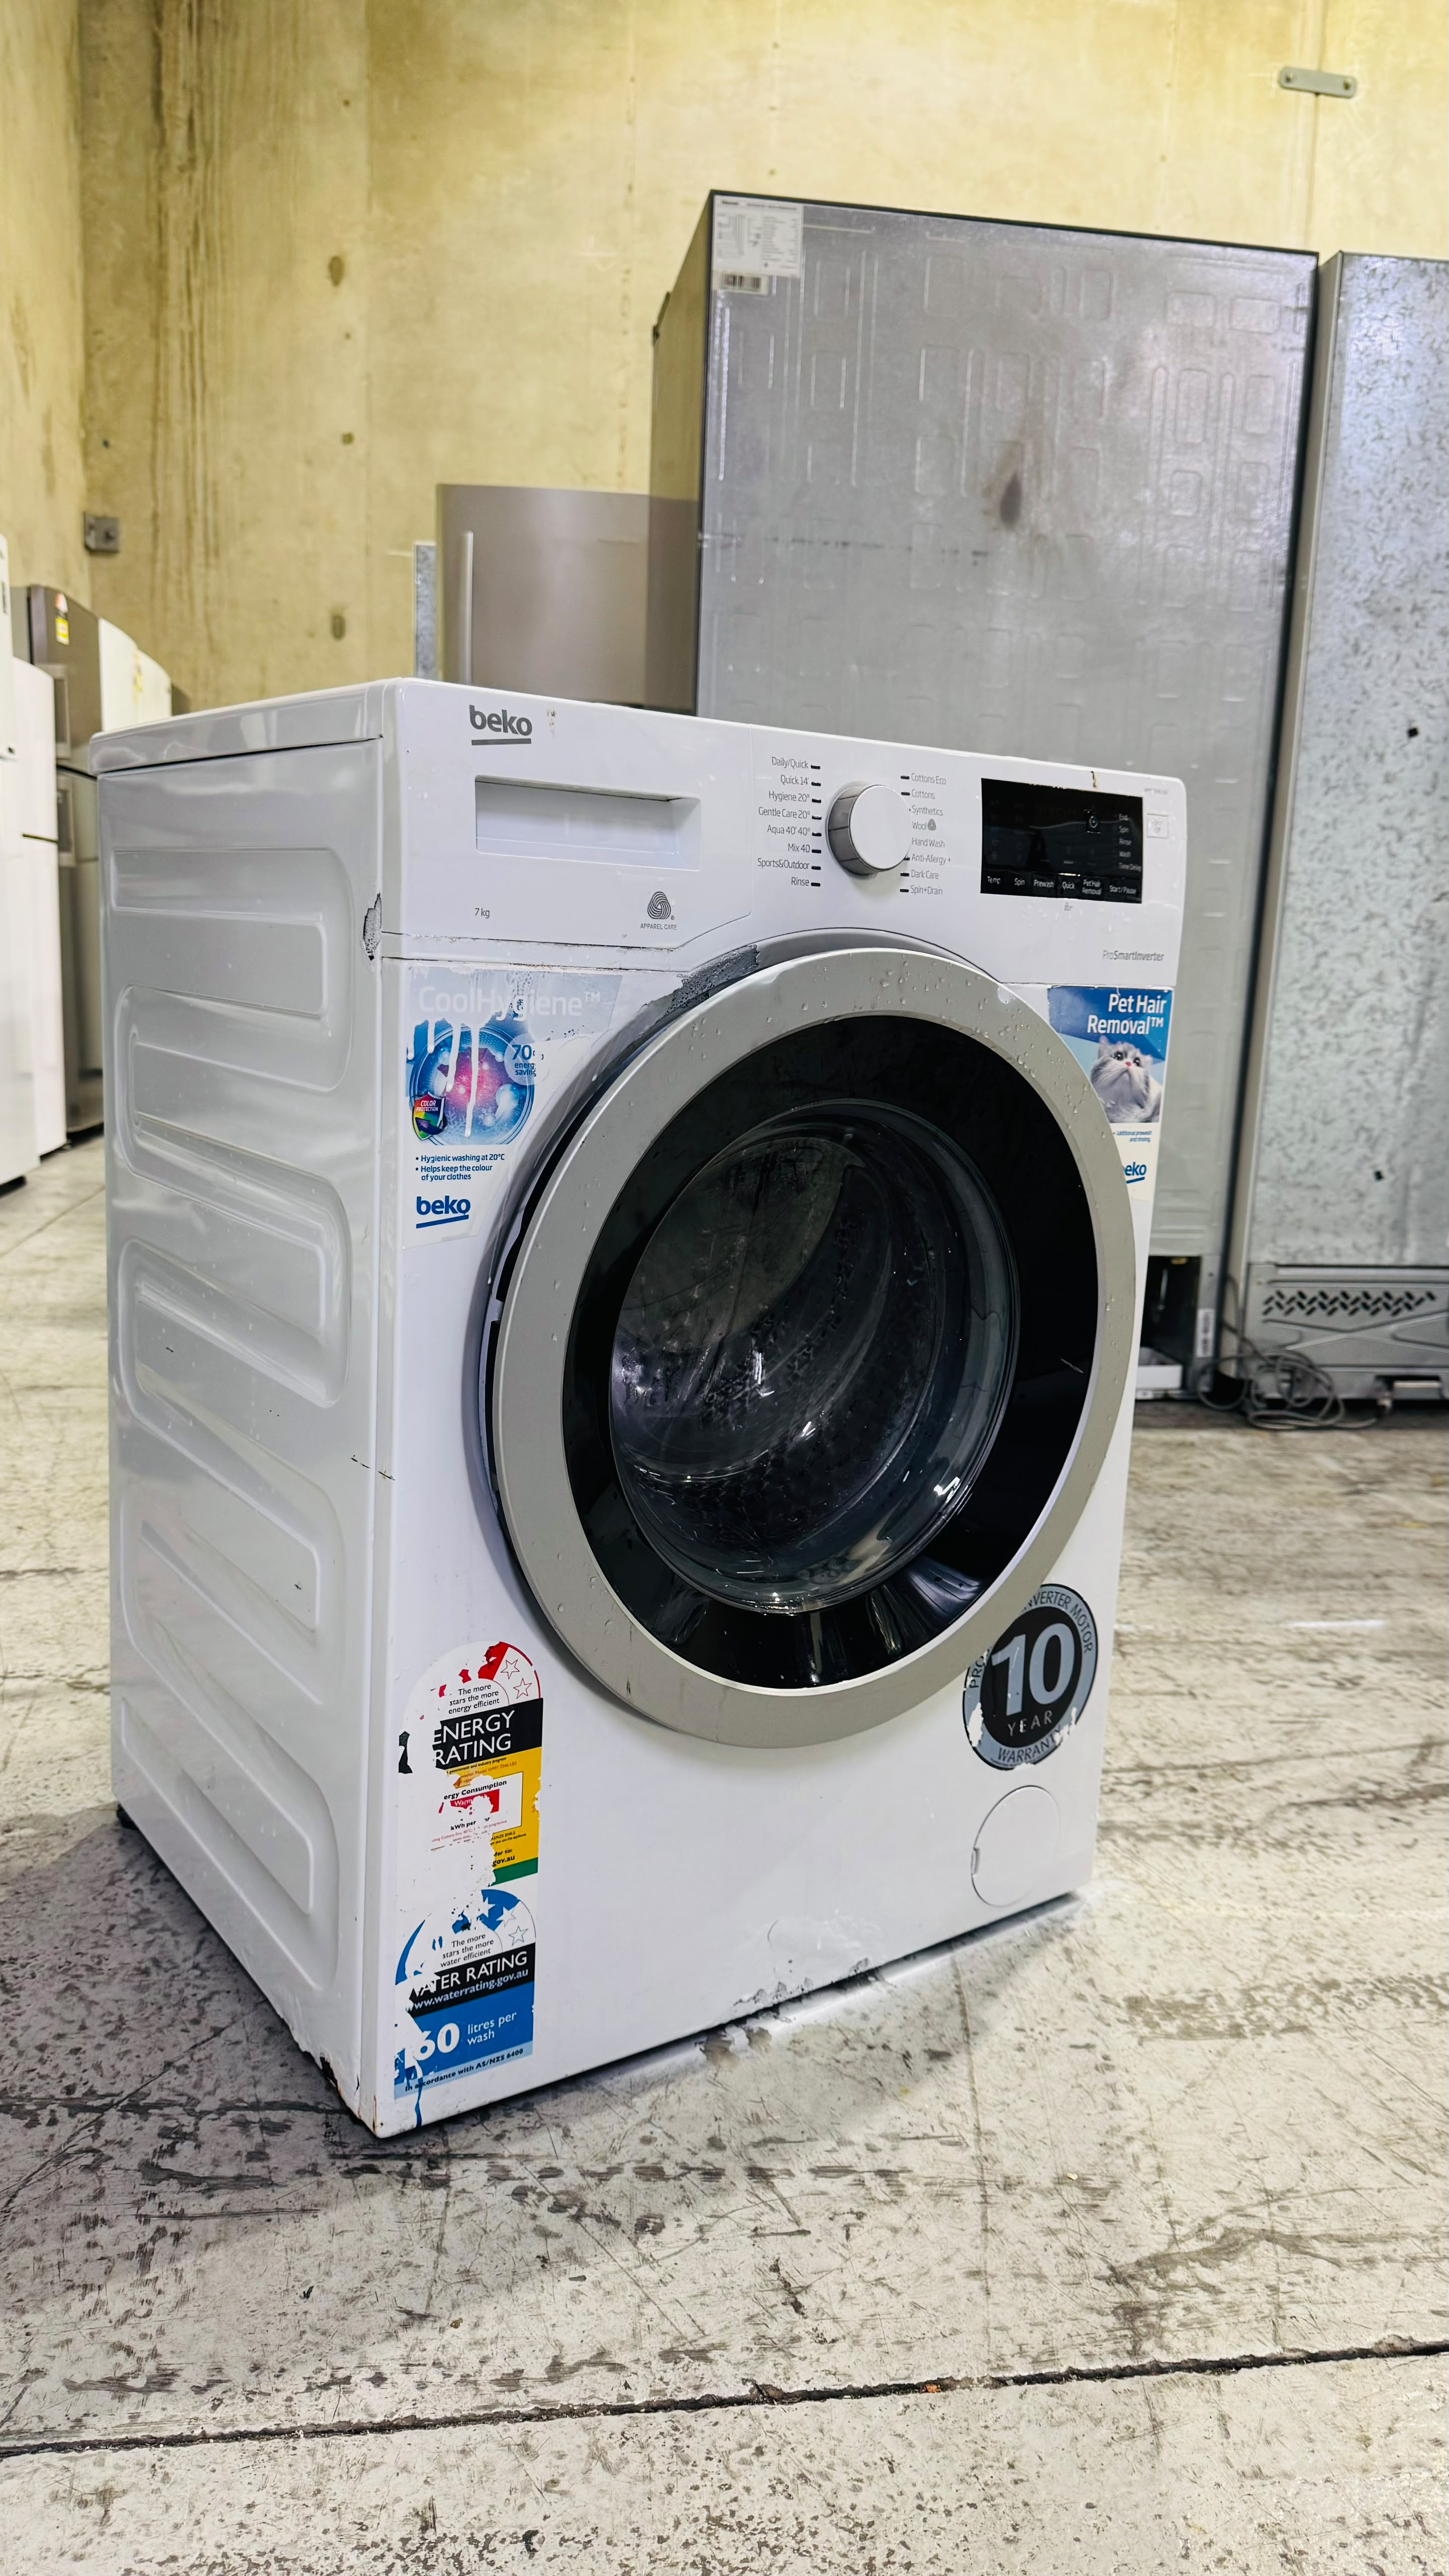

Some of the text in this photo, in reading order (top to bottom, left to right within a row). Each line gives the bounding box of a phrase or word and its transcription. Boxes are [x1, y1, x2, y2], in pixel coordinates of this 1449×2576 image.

[469, 704, 532, 736] beko
[772, 756, 809, 769] Daily/Quick
[780, 775, 799, 785] Quick
[911, 773, 946, 785] Cottons Eco
[769, 790, 796, 802] Hygiene
[911, 789, 935, 799] Cottons
[758, 807, 780, 817] Gentle
[782, 809, 797, 818] Care
[912, 805, 943, 816] Synthetics
[767, 825, 784, 835] Aqua
[912, 821, 927, 830] Wool
[788, 843, 810, 853] Mix 40
[912, 837, 945, 848] Hand Wash
[757, 858, 810, 869] Sports&Outdoor
[912, 853, 946, 865] Anti-Allergy
[911, 869, 939, 879] Dark Care
[791, 877, 809, 886] Rinse
[987, 876, 1001, 884] Temp
[1014, 878, 1025, 887] Spin
[1033, 879, 1055, 888] Prewash
[1062, 881, 1075, 890] Quick
[911, 885, 943, 896] Spin+Drain
[475, 908, 490, 919] 7 kg
[1103, 950, 1165, 961] ProSmartInverter
[1108, 993, 1167, 1013] Pet Hair
[421, 1155, 451, 1163] Hygienic
[1124, 1162, 1147, 1176] eko
[416, 1195, 471, 1215] beko
[1027, 1591, 1093, 1654] VERTER MOTOR
[991, 1623, 1075, 1716] 10
[473, 1684, 492, 1693] more
[448, 1698, 500, 1714] energy efficient
[449, 1697, 466, 1706] stars
[434, 1710, 515, 1744] ENERGY
[1008, 1710, 1053, 1736] YEAR
[433, 1733, 511, 1765] RATING
[443, 1792, 460, 1800] ergy
[461, 1781, 507, 1795] Consumption
[467, 1934, 486, 1944] more
[442, 1940, 494, 1959] stars the more
[440, 1948, 491, 1968] water efficient
[466, 1951, 527, 1982] RATING
[406, 1969, 528, 2012] www.waterrating.gov.au
[467, 2020, 495, 2035] litres
[498, 2013, 517, 2028] per
[467, 2030, 495, 2046] wash
[415, 2071, 456, 2088] accordance
[458, 2064, 474, 2075] with
[475, 2054, 505, 2069] AS/NZS
[507, 2048, 524, 2059] 6400
